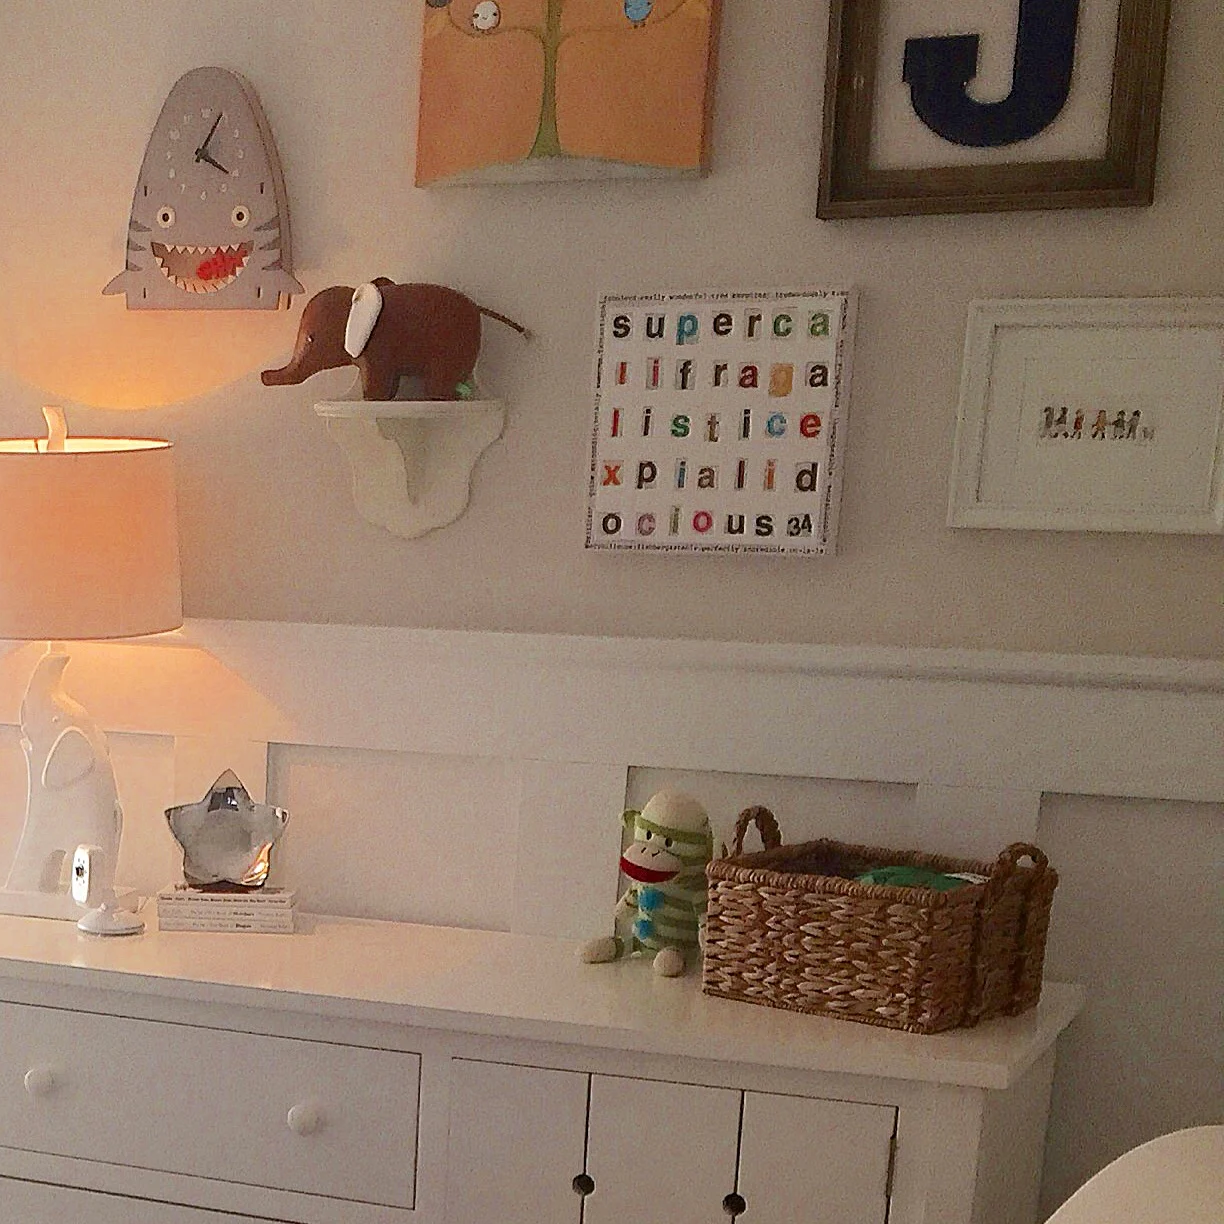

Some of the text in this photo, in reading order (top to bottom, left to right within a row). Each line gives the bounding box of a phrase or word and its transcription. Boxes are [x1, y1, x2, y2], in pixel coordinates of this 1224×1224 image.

[612, 312, 830, 345] superca
[611, 408, 822, 443] listice
[603, 459, 818, 491] xpialid
